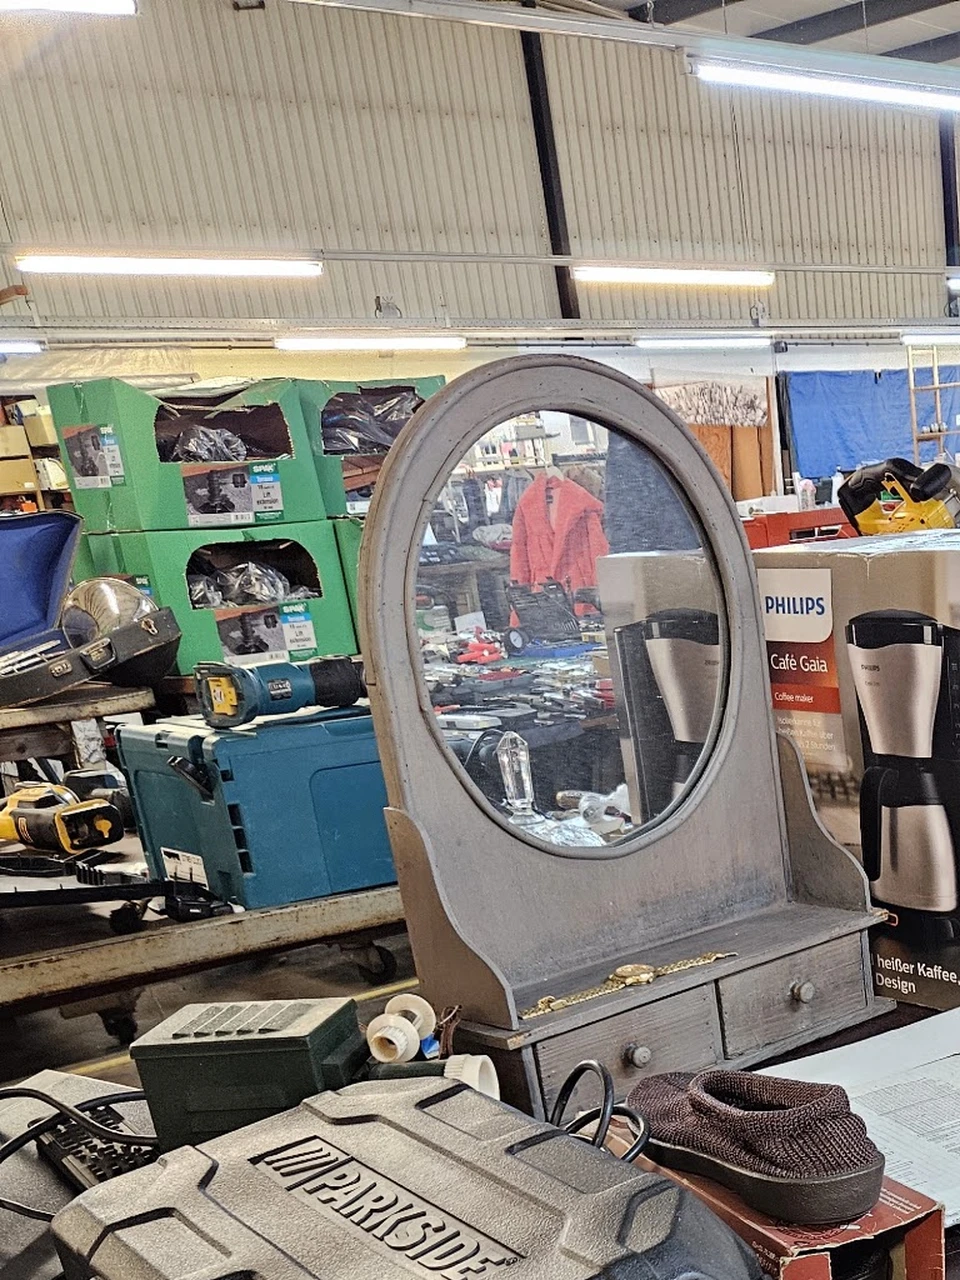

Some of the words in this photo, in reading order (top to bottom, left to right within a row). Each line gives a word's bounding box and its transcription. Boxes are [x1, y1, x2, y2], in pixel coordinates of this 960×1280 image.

[765, 596, 826, 615] PHILIPS
[770, 653, 797, 671] Café
[799, 655, 828, 673] Gaia
[774, 691, 795, 702] Coffee
[795, 693, 814, 703] maker
[877, 955, 915, 975] heißer
[917, 961, 960, 986] Kaffee,
[875, 973, 916, 994] Design
